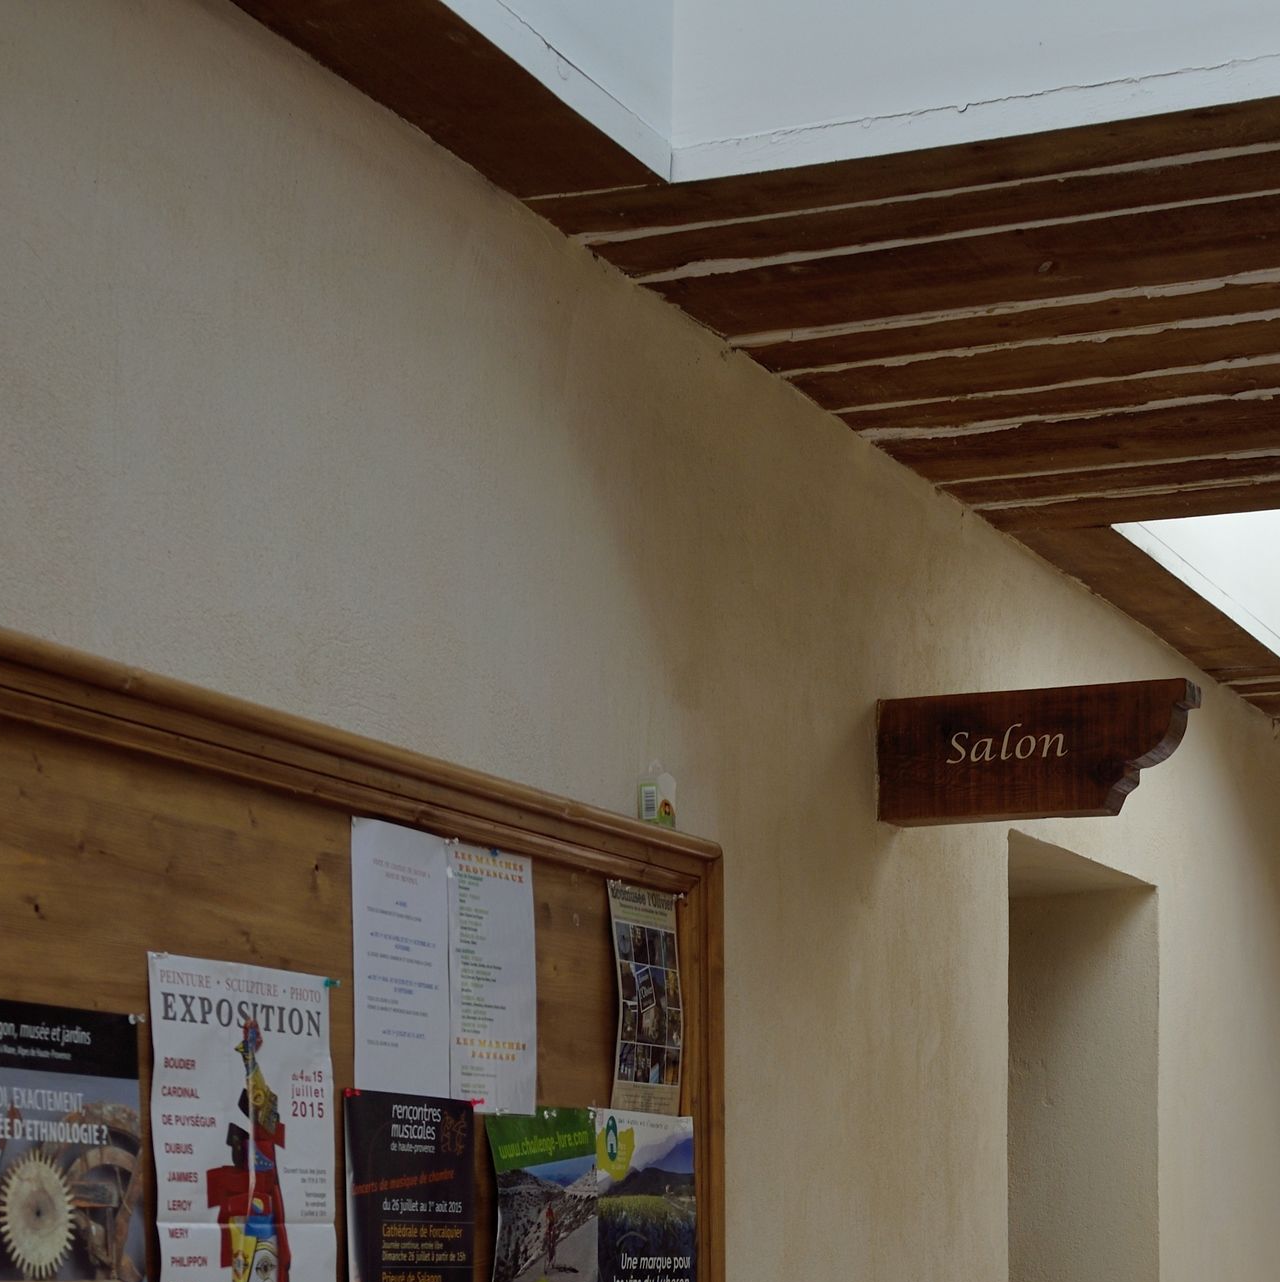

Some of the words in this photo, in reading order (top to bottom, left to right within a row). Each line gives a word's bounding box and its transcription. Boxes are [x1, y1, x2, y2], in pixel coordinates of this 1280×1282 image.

[946, 722, 1069, 765] Salon
[159, 969, 211, 989] PEINTURE
[225, 978, 278, 998] SCULPTURE
[290, 987, 321, 1004] PHOTO
[161, 991, 321, 1038] EXPOSITION
[19, 1021, 49, 1041] musée
[51, 1026, 61, 1042] et
[60, 1024, 92, 1047] jardins
[163, 1057, 196, 1070] BOUDIER
[313, 1071, 323, 1082] 15
[161, 1086, 200, 1099] CARDINAL
[291, 1084, 324, 1099] juillet
[13, 1087, 86, 1117] EXACTEMENT,
[292, 1101, 324, 1118] 2015
[162, 1114, 173, 1125] DE
[175, 1113, 216, 1127] PUYSÉGUR
[392, 1104, 442, 1122] rencontres
[391, 1120, 436, 1140] musicales
[164, 1142, 193, 1154] DUBUIS
[390, 1141, 398, 1151] de
[498, 1130, 589, 1160] www.challenge-lure.com
[168, 1171, 198, 1183] JAMMES
[167, 1200, 192, 1211] LEROY
[382, 1197, 391, 1211] du
[391, 1198, 399, 1211] 26
[400, 1198, 418, 1214] juillet
[419, 1202, 427, 1212] au
[448, 1201, 462, 1213] 2015
[382, 1223, 418, 1238] Cathédrale
[419, 1225, 428, 1238] de
[429, 1224, 464, 1240] Forcalquier
[171, 1257, 208, 1267] PHILIPPON
[621, 1253, 638, 1270] Une
[639, 1256, 672, 1273] marque
[673, 1256, 691, 1272] pour
